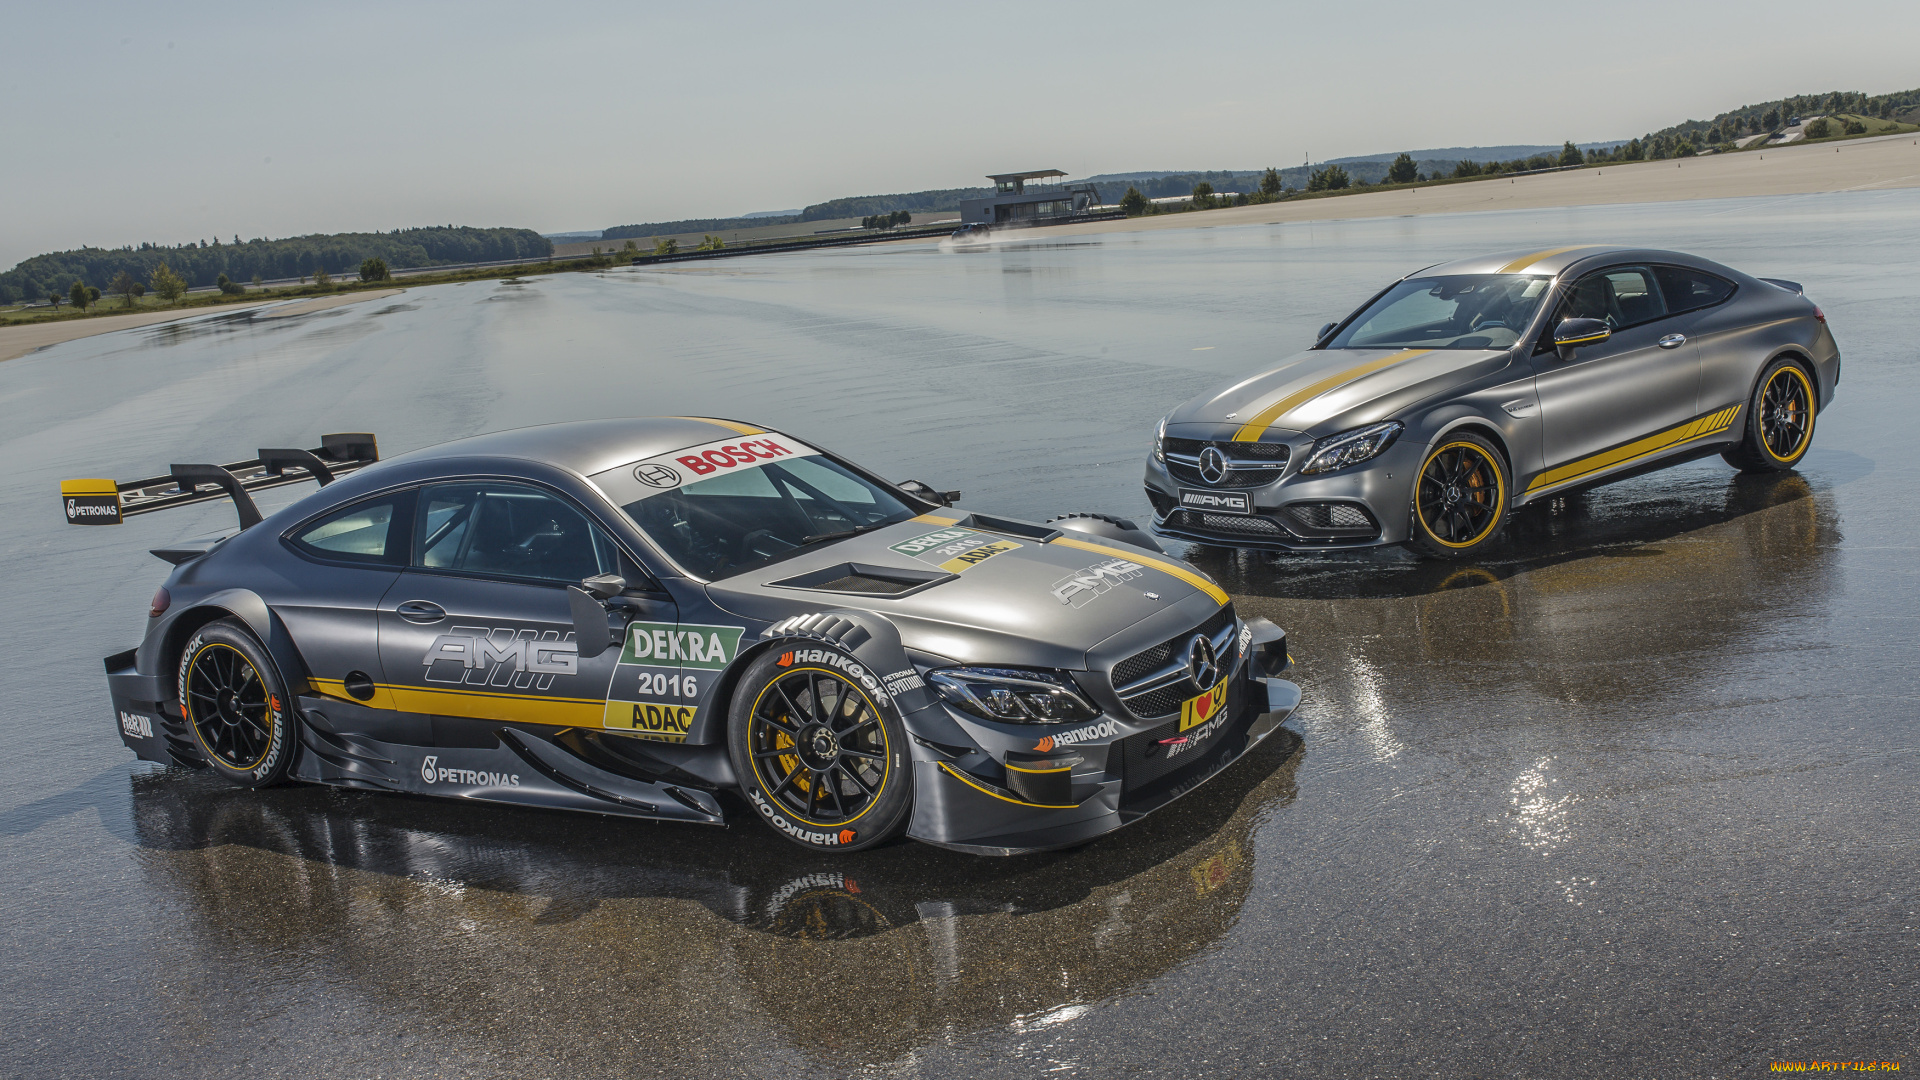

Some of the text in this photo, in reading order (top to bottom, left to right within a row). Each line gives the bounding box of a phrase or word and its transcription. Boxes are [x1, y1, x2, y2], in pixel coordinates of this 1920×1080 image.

[675, 438, 793, 475] BOSCH
[76, 505, 117, 515] PETRONAS
[1199, 495, 1245, 508] AMG
[896, 530, 970, 552] DEKRA
[936, 539, 984, 556] 2016
[957, 545, 1009, 564] ADAC
[1050, 559, 1145, 606] AMG
[422, 634, 579, 675] AMG
[632, 628, 727, 663] DEKRA
[638, 672, 698, 698] 2016
[882, 669, 916, 682] PETRONAS
[887, 675, 926, 696] SYNTIUM
[632, 704, 691, 733] ADAC
[438, 767, 520, 787] PETRONAS
